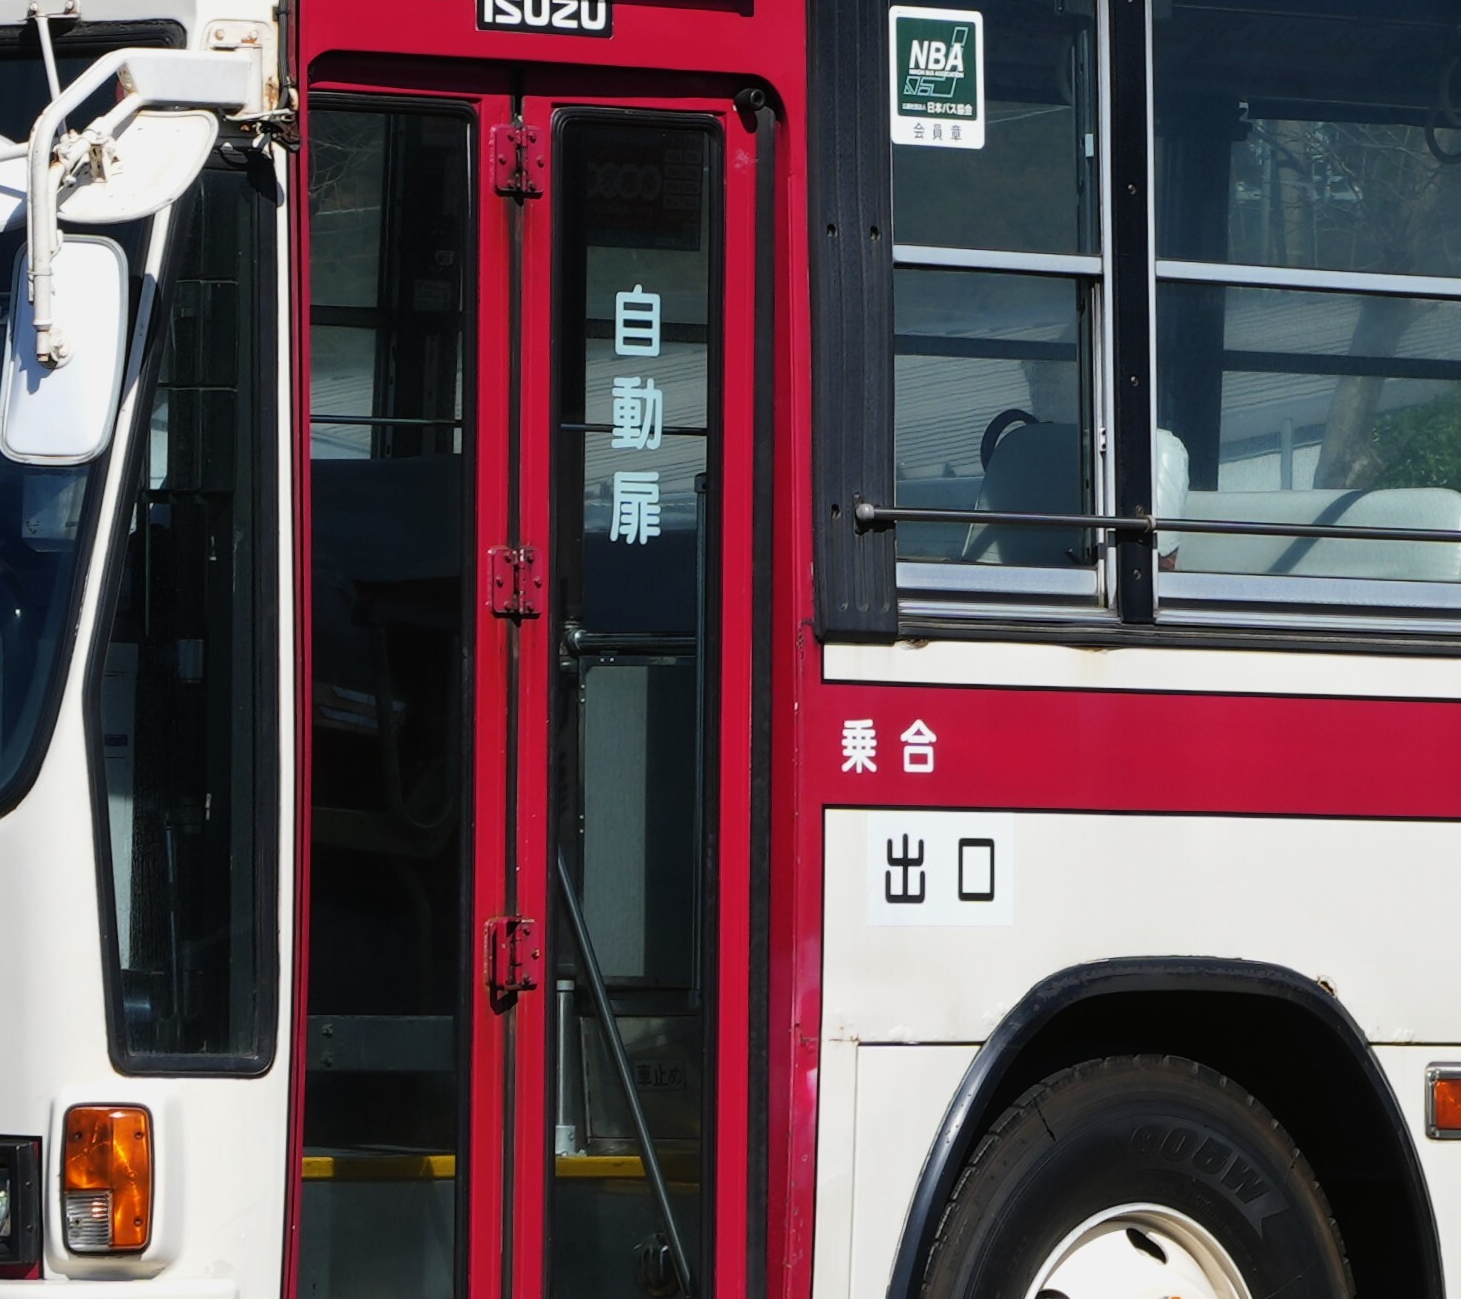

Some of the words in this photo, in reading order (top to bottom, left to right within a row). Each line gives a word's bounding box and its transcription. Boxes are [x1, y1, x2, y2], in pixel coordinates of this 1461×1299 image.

[909, 39, 965, 73] NBA
[913, 121, 963, 141] 会員章
[610, 284, 662, 545] 自動扉
[841, 719, 936, 774] 乗合
[885, 833, 995, 904] 出口
